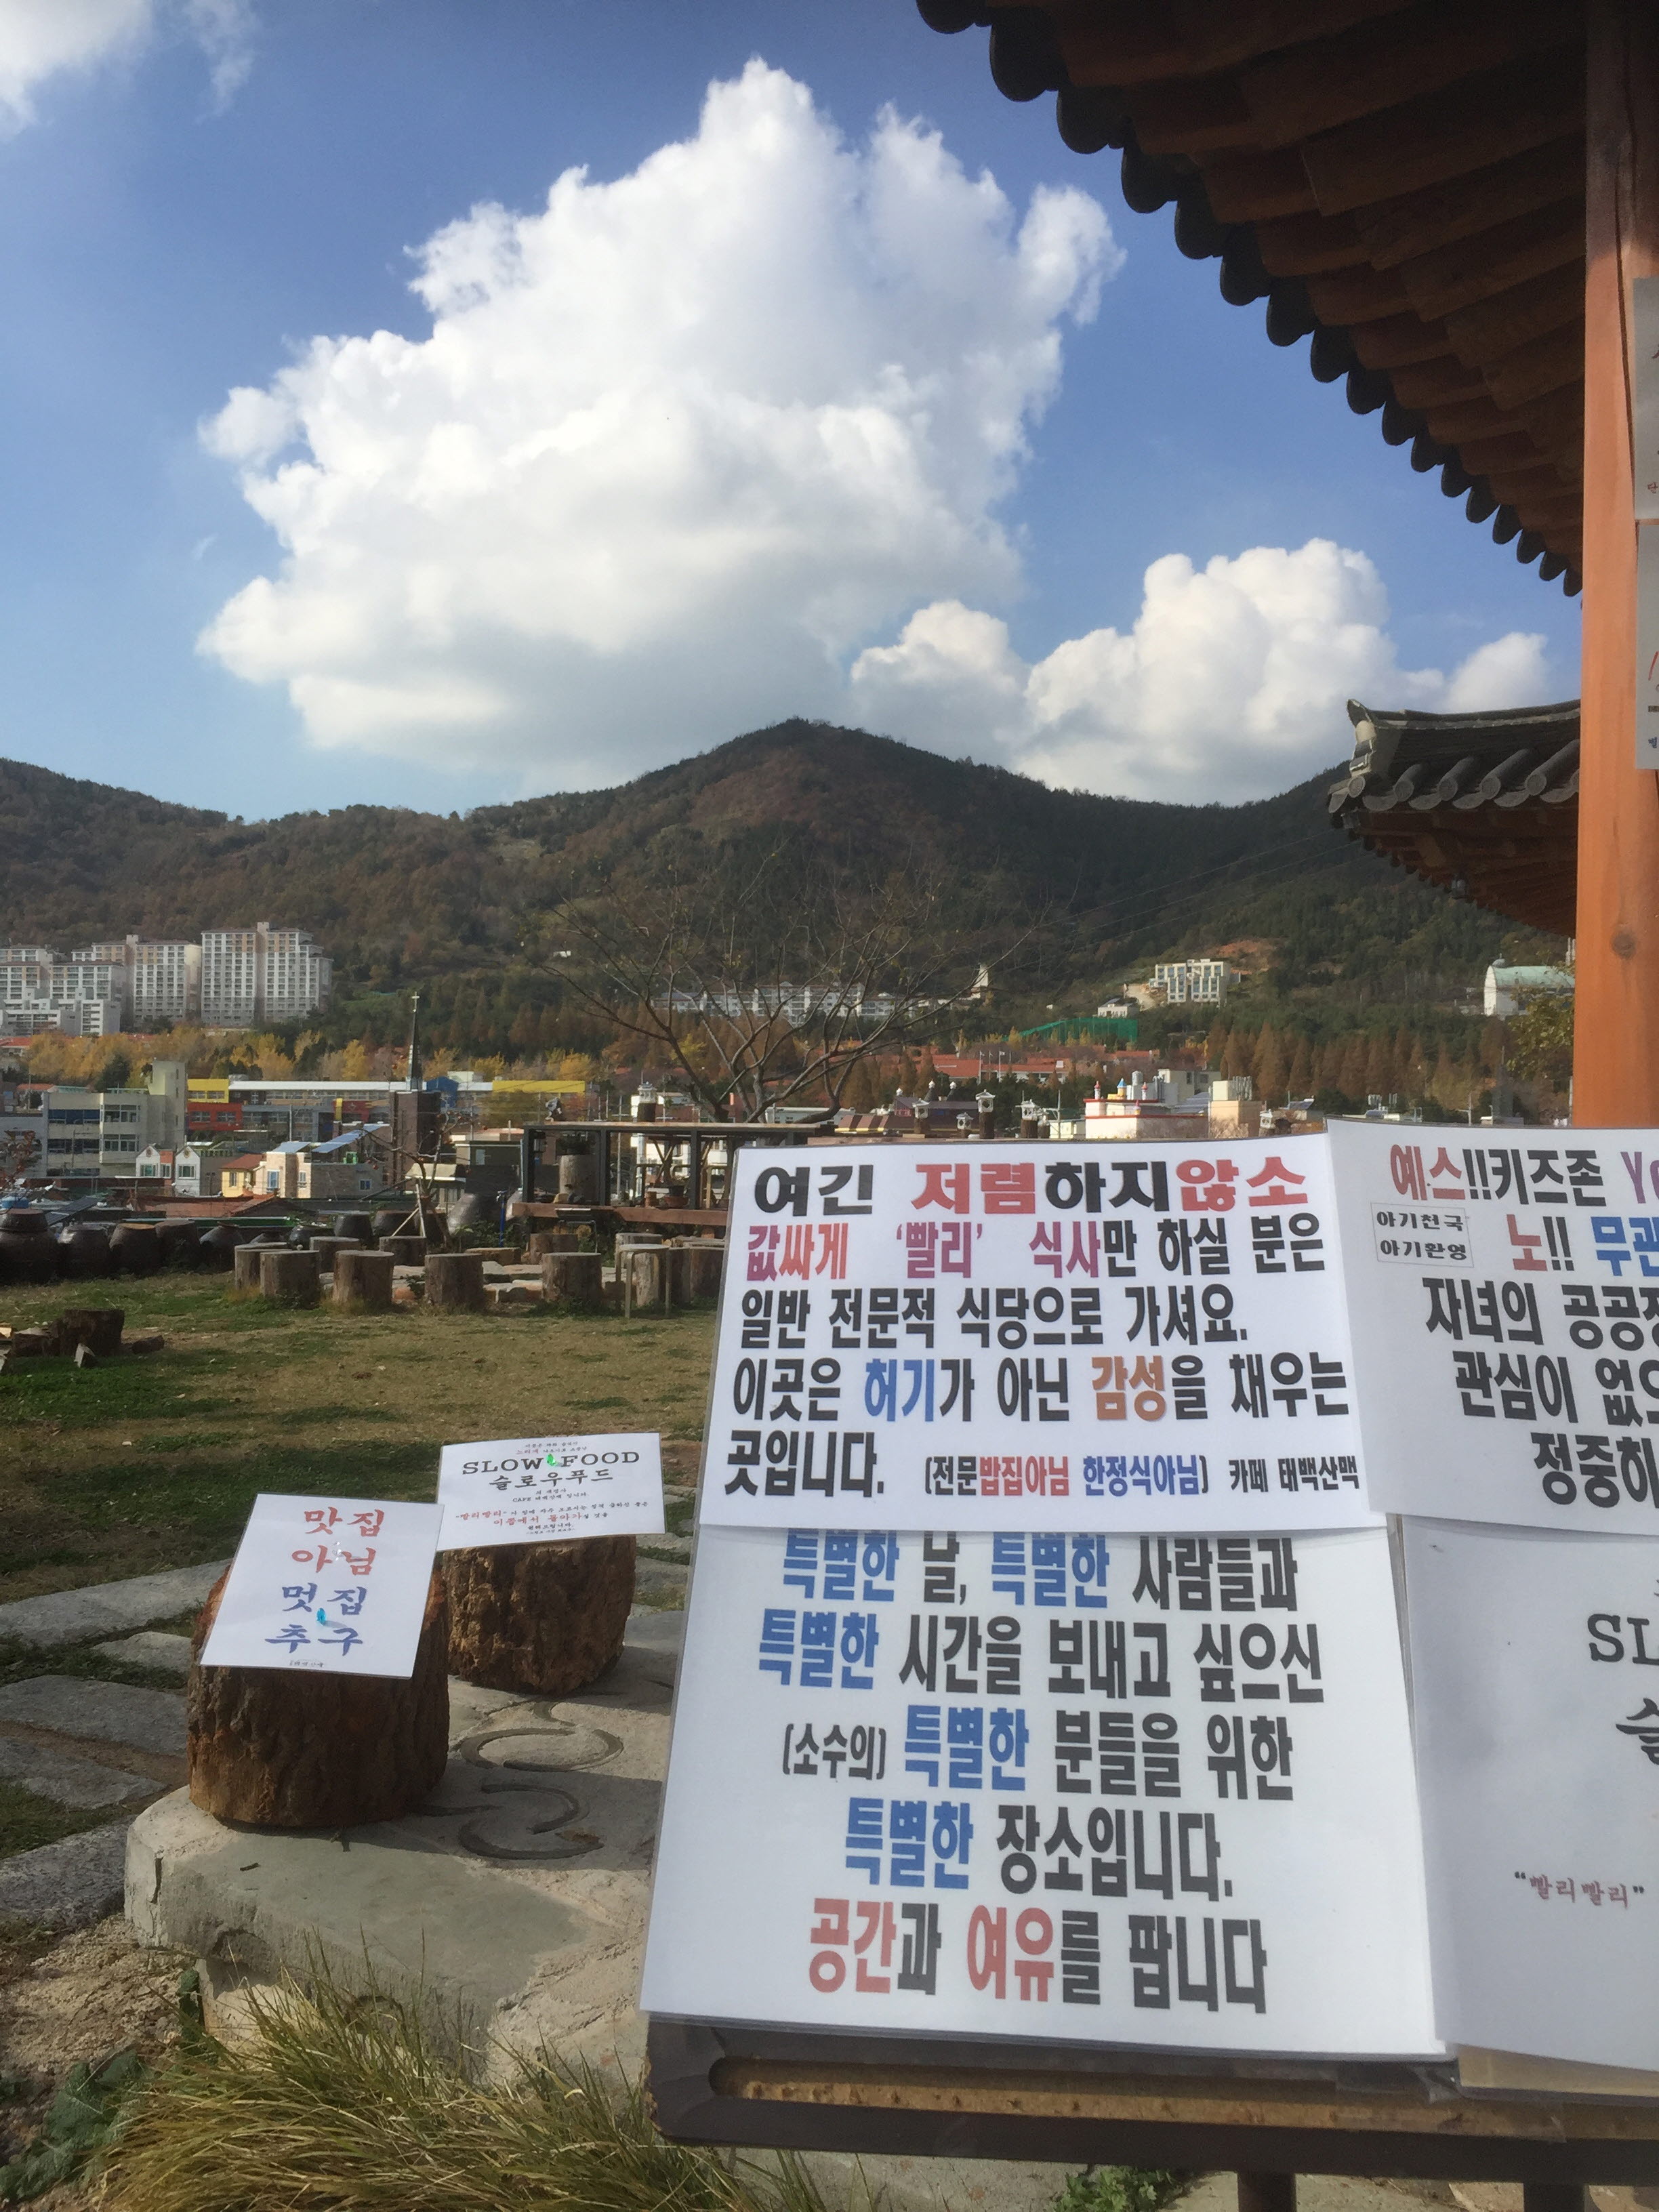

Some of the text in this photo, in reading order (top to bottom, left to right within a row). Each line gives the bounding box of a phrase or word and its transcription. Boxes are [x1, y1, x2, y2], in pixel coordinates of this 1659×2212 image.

[754, 1158, 1310, 1216] 여긴 저렴하지않소
[1391, 1145, 1606, 1206] 예스!!키즈존
[747, 1223, 848, 1281] 값싸게
[1029, 1220, 1136, 1278] 식사만
[1158, 1218, 1229, 1275] 하실
[1251, 1213, 1324, 1273] 분은
[1377, 1212, 1463, 1231] 아기천국
[1380, 1240, 1467, 1260] 아기환영
[1507, 1214, 1574, 1271] 노!!
[741, 1284, 1247, 1349] 일반 전문적 식당으로 가셔요.
[1422, 1277, 1544, 1345] 자녀의
[734, 1352, 1349, 1422] 이곳은 허기가 아닌 감성을 채우는
[1453, 1351, 1578, 1423] 관심이
[462, 1452, 640, 1475] SLOW FOOD
[488, 1468, 613, 1492] 슬로우푸드
[725, 1431, 884, 1497] 곳입니다.
[1229, 1459, 1268, 1492] 카페
[1278, 1456, 1359, 1492] 태백산맥
[1531, 1433, 1659, 1509] 정중히
[304, 1507, 385, 1537] 맛집
[291, 1544, 377, 1576] 아님
[783, 1533, 900, 1601] 특별한
[992, 1534, 1109, 1607] 특별한
[1132, 1538, 1297, 1611] 사람들과
[281, 1582, 367, 1616] 멋집
[264, 1623, 363, 1657] 추구
[759, 1609, 1324, 1703] 특별한 시간을 보내고 싶으신
[905, 1705, 1029, 1790] 특별한
[1055, 1711, 1181, 1797] 분들을
[1207, 1715, 1293, 1800] 위한
[846, 1797, 1232, 1902] 특별한 장소입니다.
[810, 1898, 1267, 2013] 공간과 여유를 팝니다
